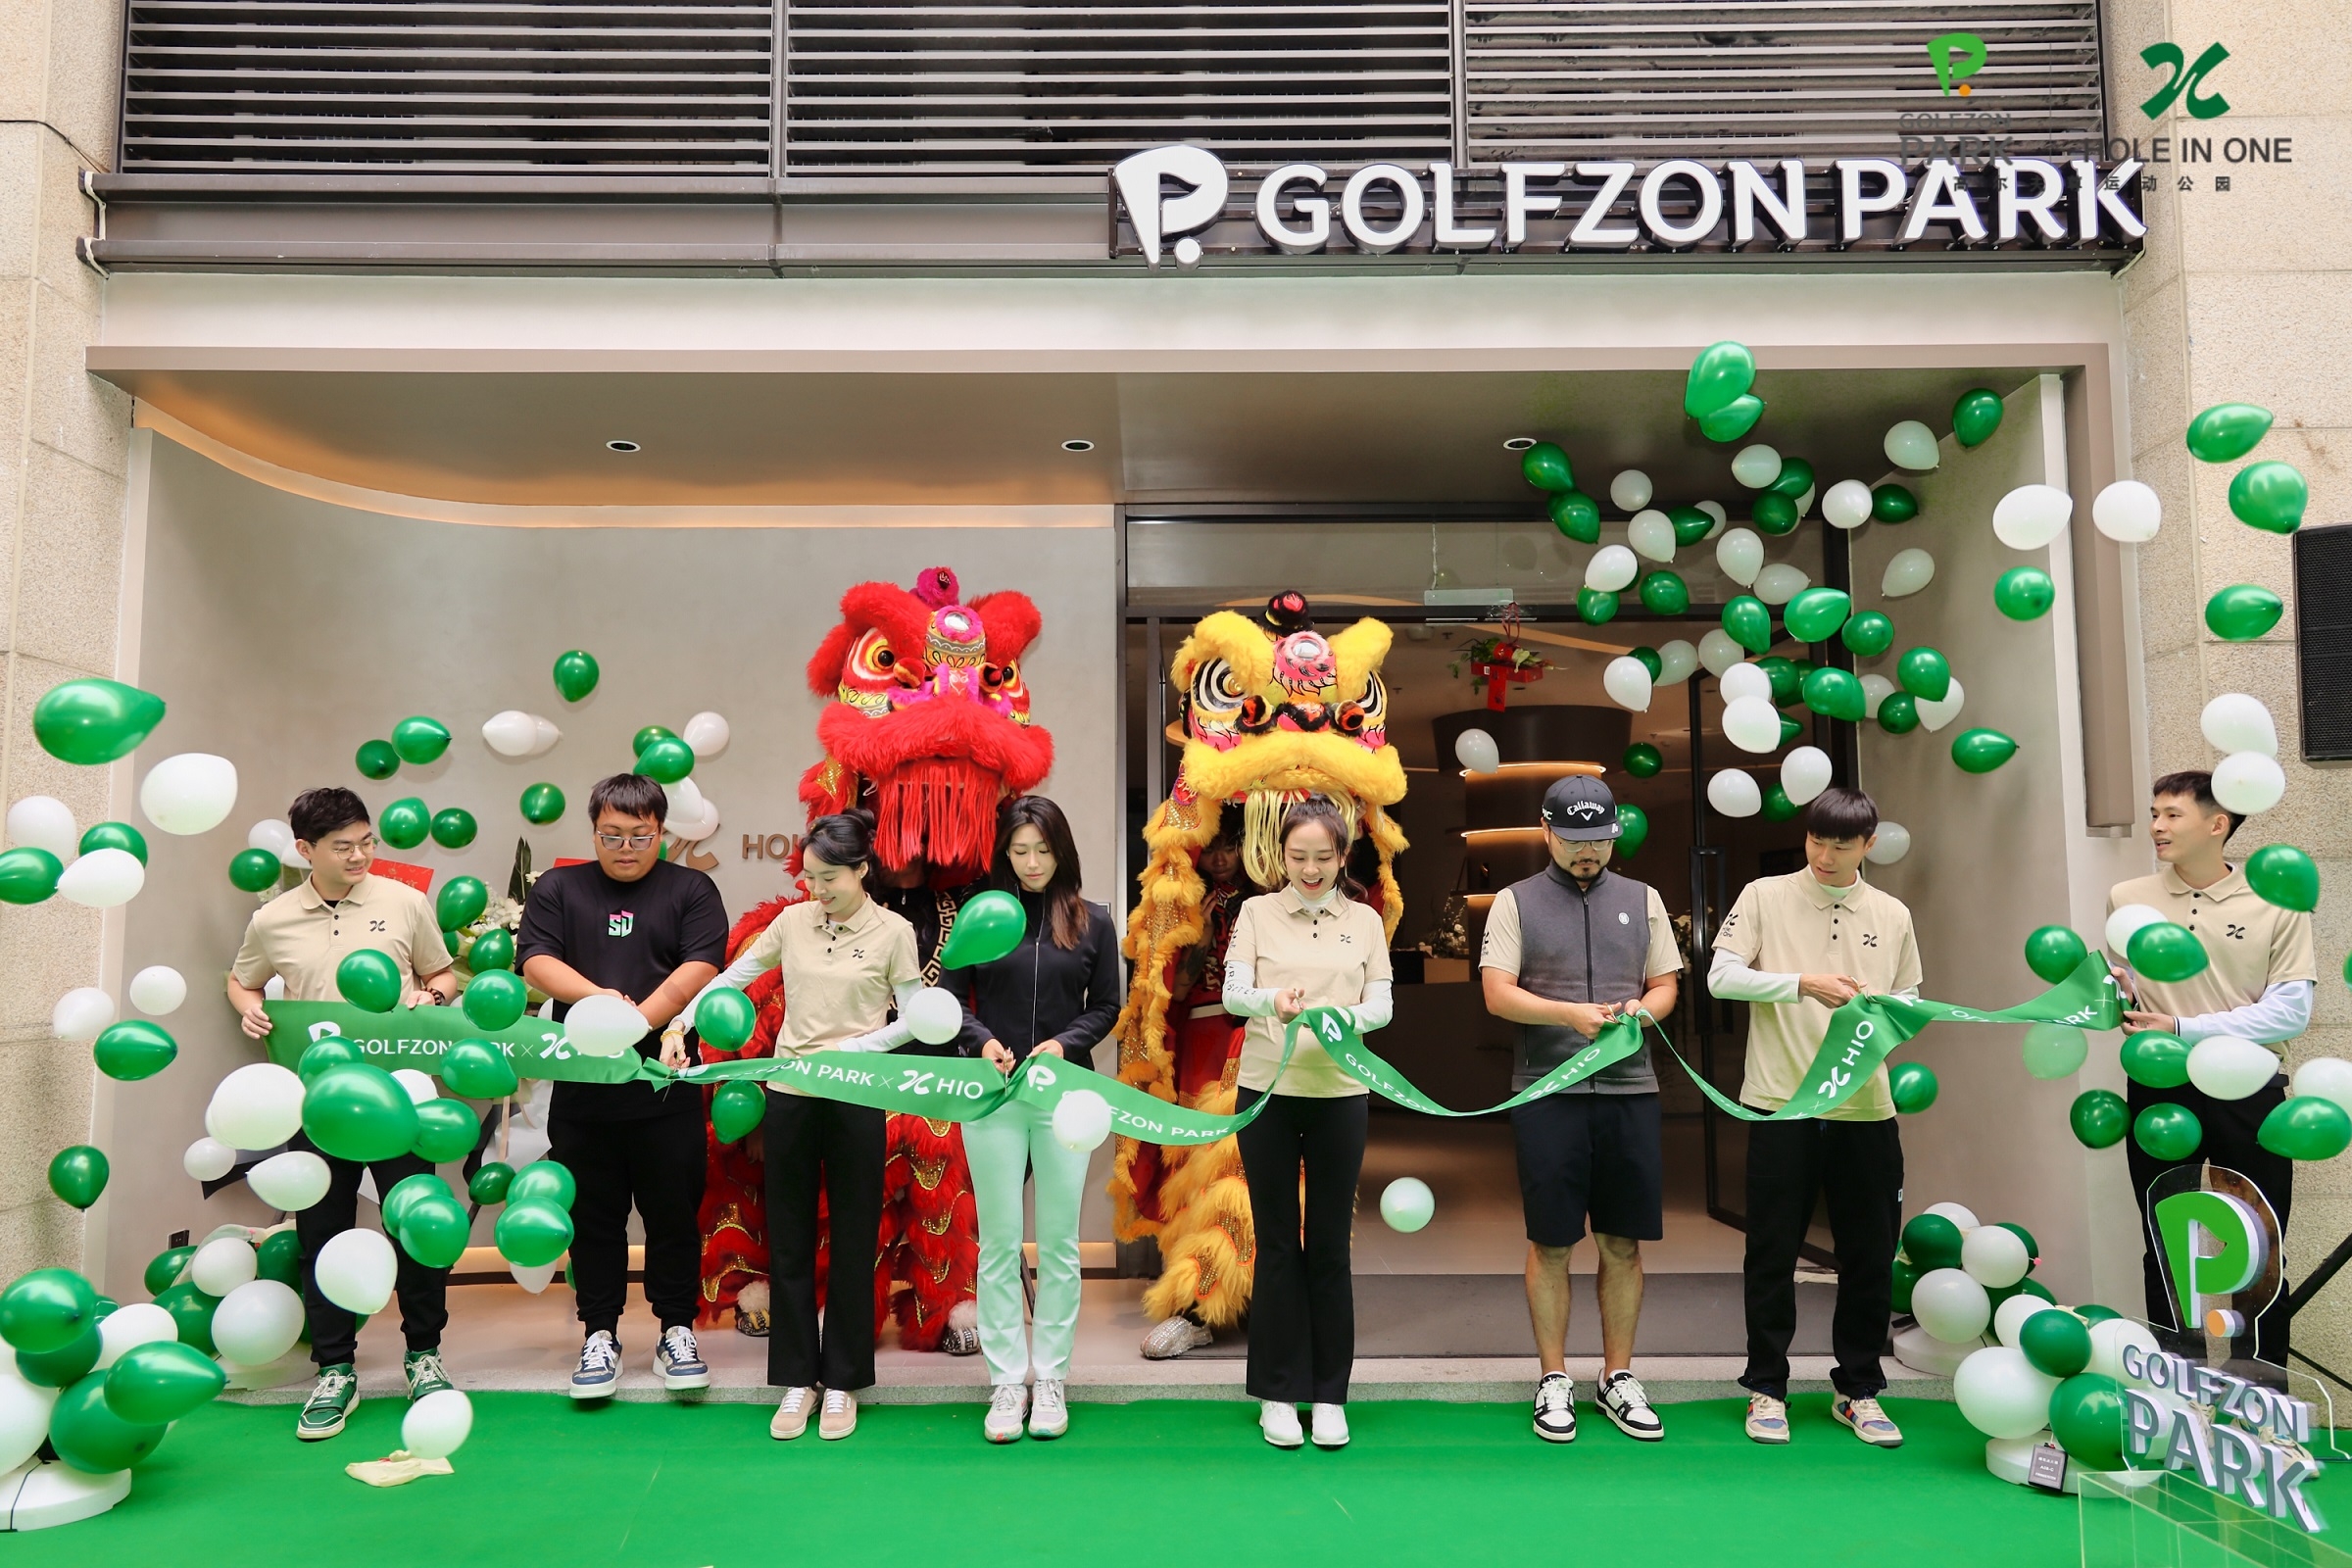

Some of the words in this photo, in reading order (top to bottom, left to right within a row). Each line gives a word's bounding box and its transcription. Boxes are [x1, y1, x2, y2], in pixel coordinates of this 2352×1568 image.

[1255, 160, 1808, 247] GOLFZON
[1835, 158, 2148, 244] PARK
[1566, 800, 1605, 816] Callaway
[1841, 1019, 1875, 1067] HIO
[816, 1064, 876, 1088] PARK
[936, 1077, 985, 1100] HIO
[2123, 1344, 2310, 1444] GOLFZON
[2125, 1389, 2321, 1533] PARK
